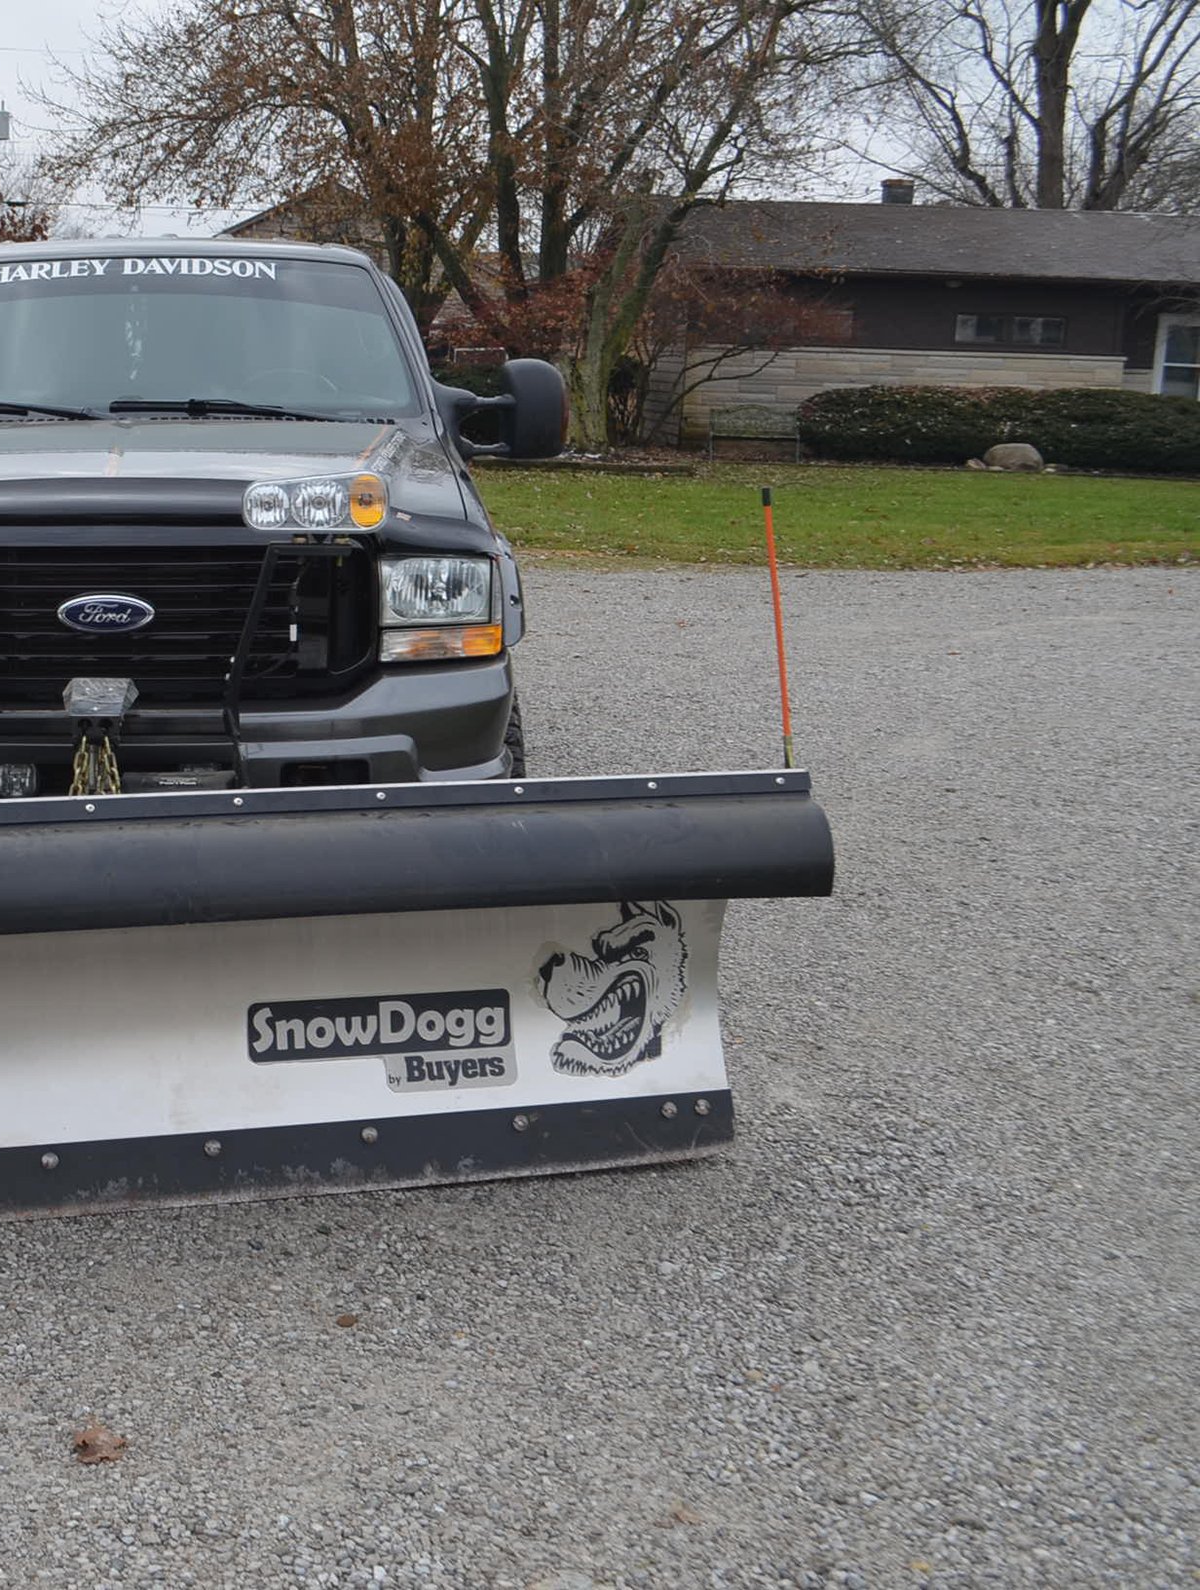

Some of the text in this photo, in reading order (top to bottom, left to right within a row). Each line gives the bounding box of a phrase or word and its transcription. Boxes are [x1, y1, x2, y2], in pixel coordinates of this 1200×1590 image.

[121, 258, 277, 281] DAVIDSON
[79, 602, 132, 623] Ford
[252, 1001, 505, 1053] SnowDogg
[388, 1055, 506, 1086] by Buyers
